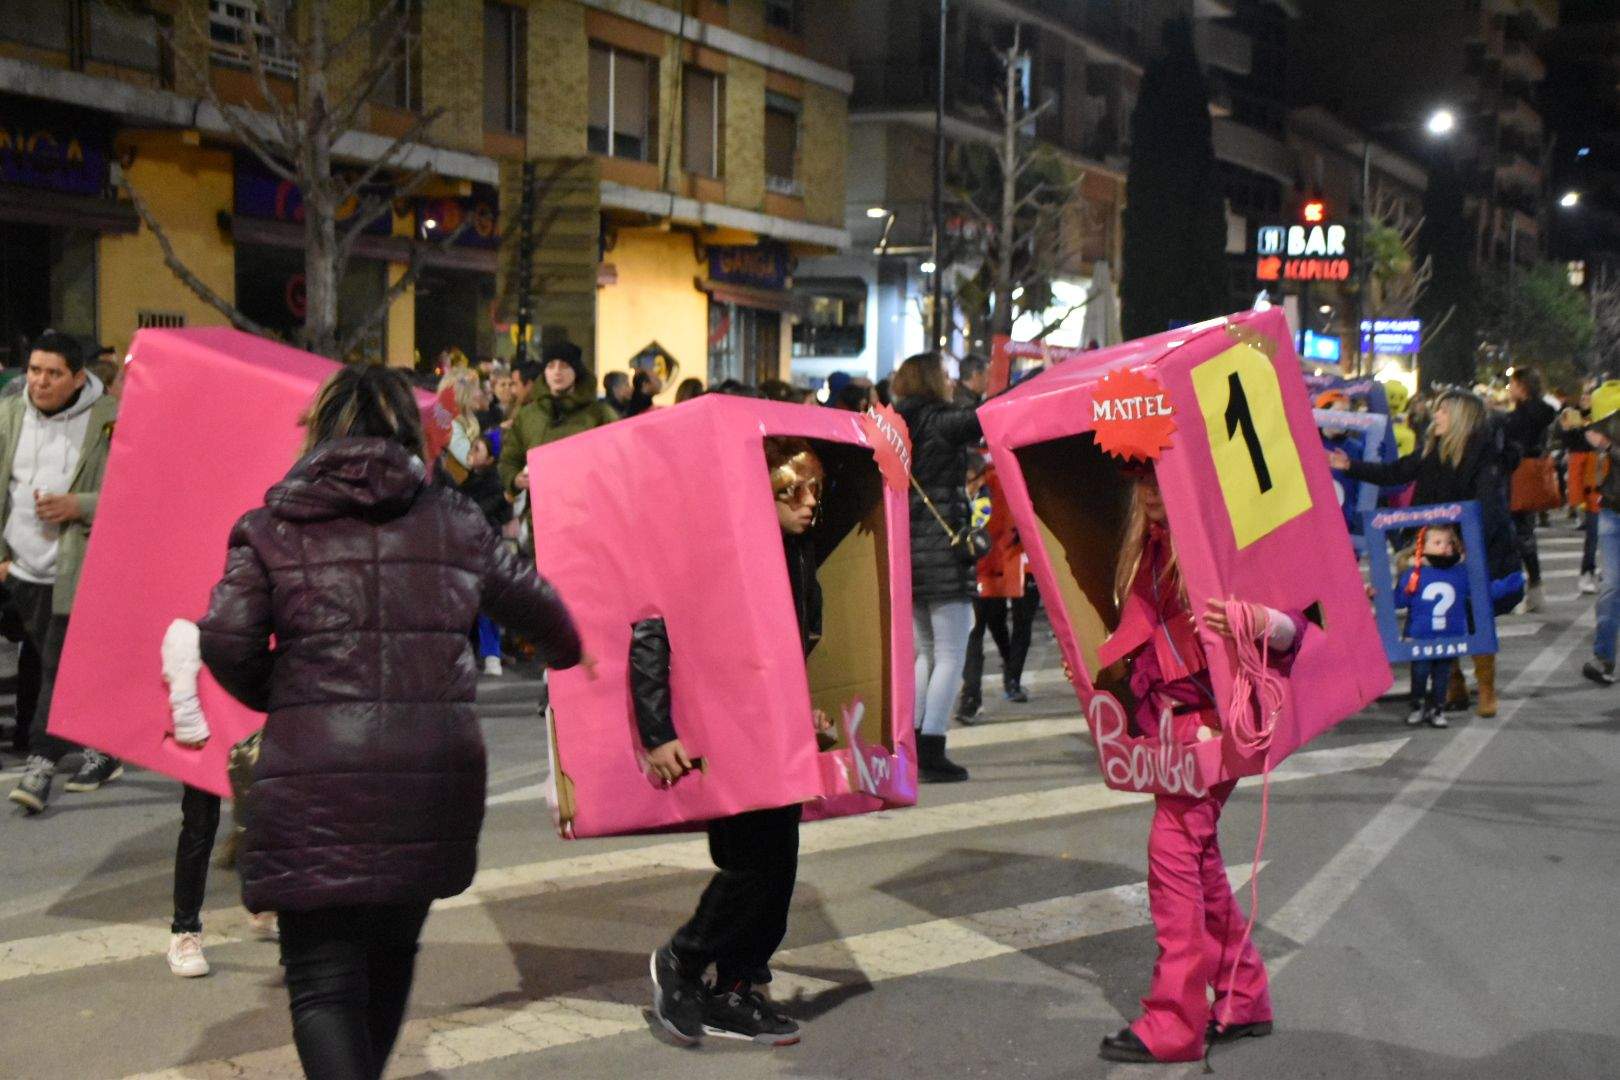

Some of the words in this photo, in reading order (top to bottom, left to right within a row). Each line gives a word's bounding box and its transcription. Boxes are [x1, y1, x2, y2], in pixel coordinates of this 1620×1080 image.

[1288, 225, 1346, 256] BAR
[1092, 394, 1173, 421] MATTEL
[867, 405, 910, 477] MATTEL
[1225, 371, 1272, 494] 1
[1412, 642, 1468, 657] SUSAN
